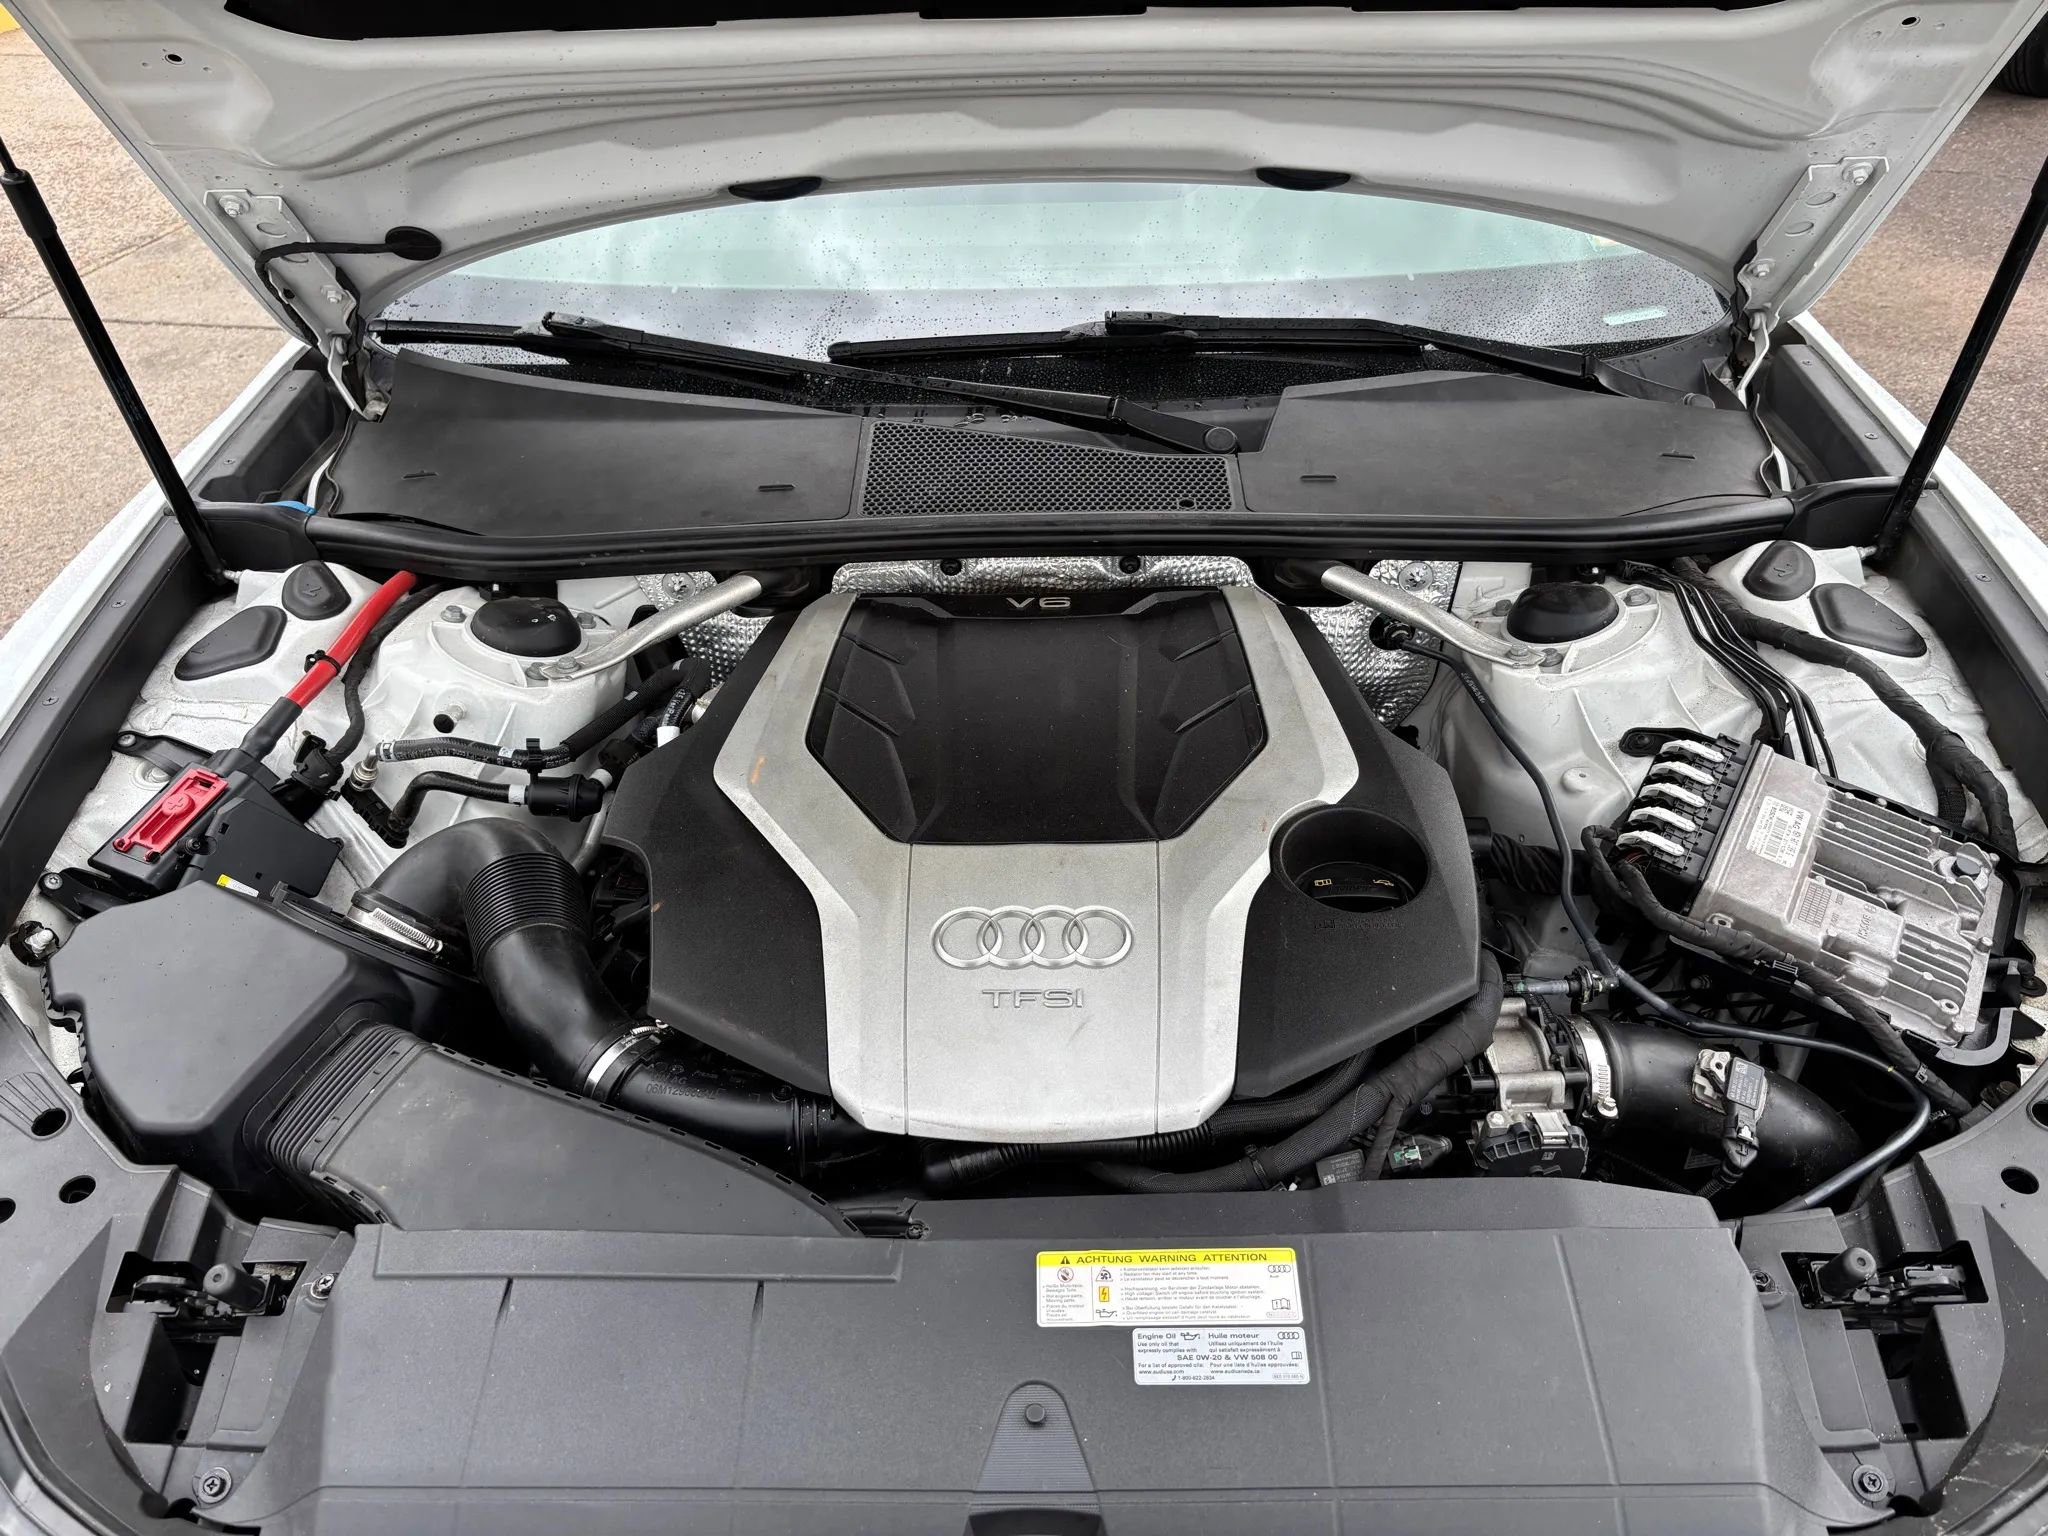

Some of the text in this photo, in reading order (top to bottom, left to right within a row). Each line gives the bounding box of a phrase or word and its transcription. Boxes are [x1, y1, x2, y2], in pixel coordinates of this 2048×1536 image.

[1006, 596, 1071, 608] V6
[1856, 914, 1871, 940] BOSCH
[982, 988, 1083, 1008] TFSI
[1076, 1253, 1267, 1264] ACHTUNG WARNING ATTENTION
